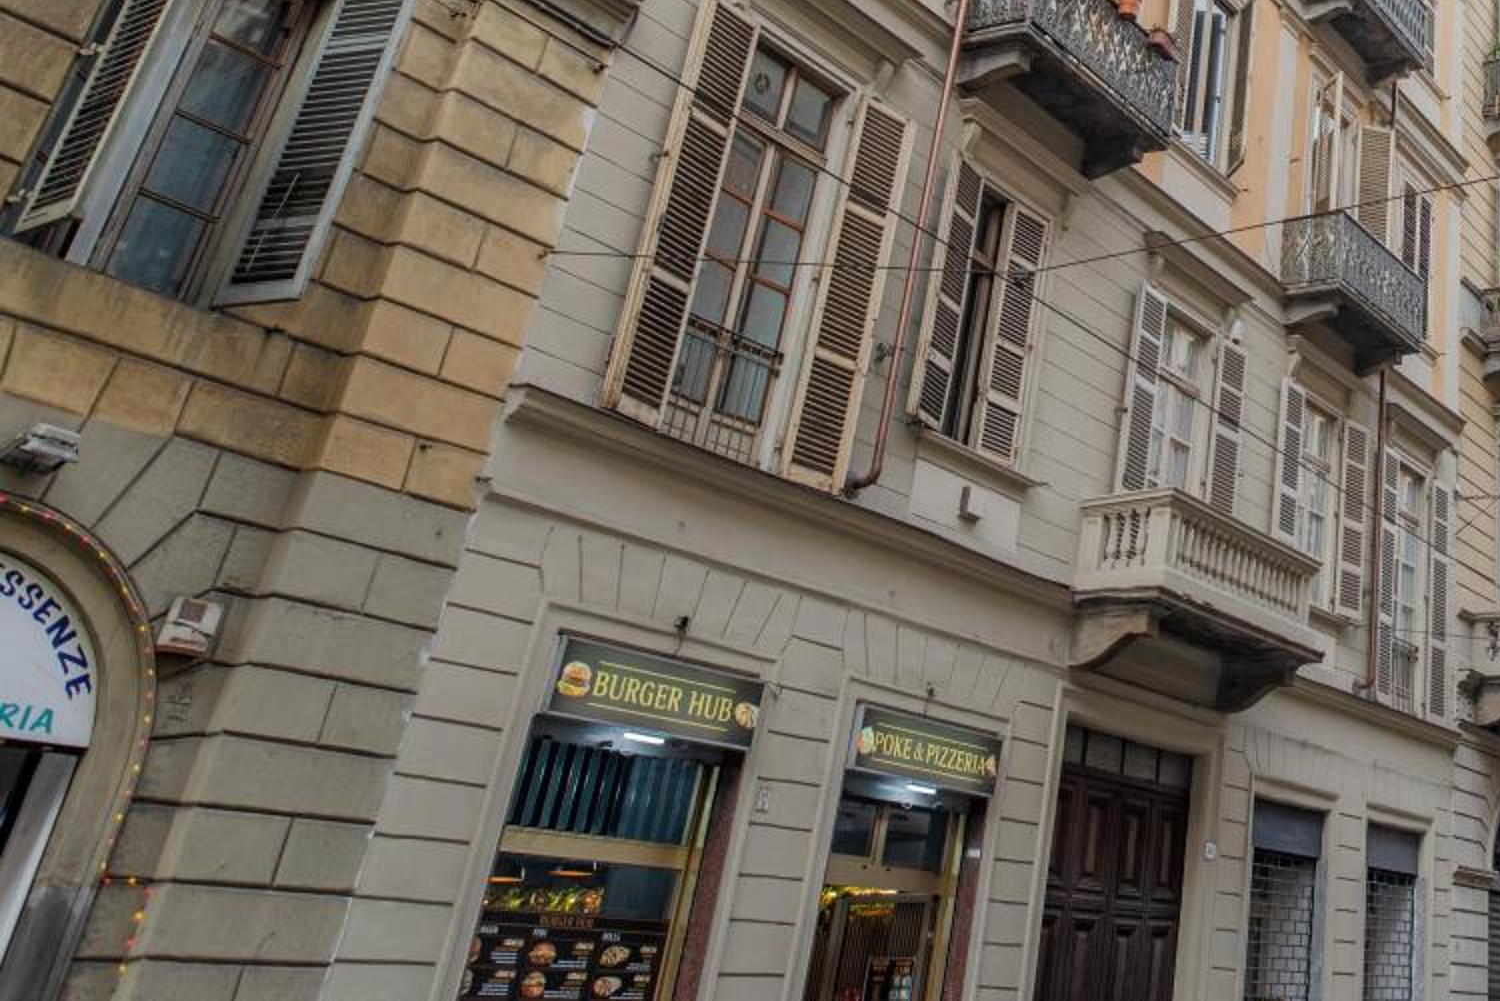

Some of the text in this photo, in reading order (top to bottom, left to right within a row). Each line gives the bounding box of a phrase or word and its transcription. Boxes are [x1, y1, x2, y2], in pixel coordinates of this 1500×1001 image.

[0, 562, 92, 701] SSENZE
[593, 671, 733, 722] BURGER HUB
[875, 732, 986, 775] POKE & PIZZERIA
